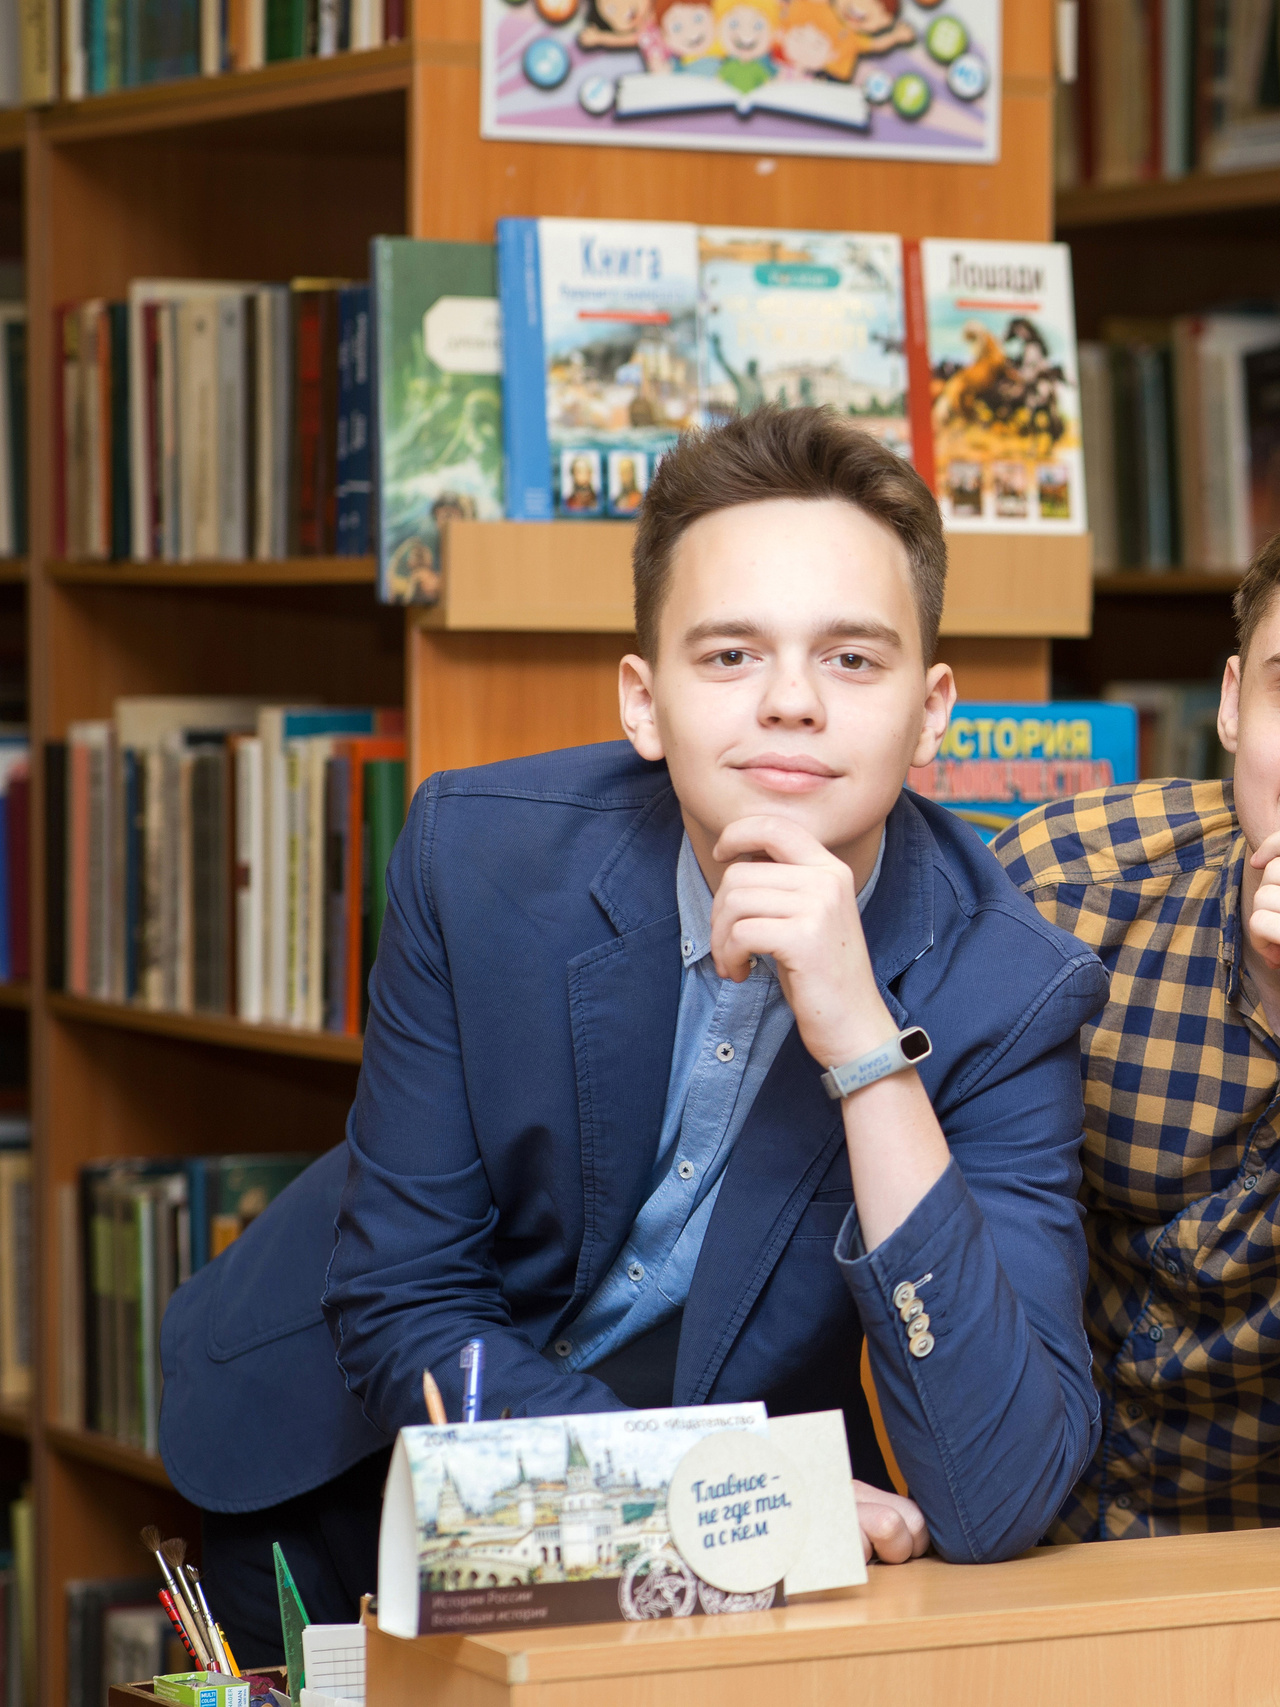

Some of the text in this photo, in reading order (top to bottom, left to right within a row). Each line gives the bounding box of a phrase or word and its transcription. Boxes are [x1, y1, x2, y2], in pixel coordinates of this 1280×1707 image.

[579, 232, 662, 281] Книга
[949, 252, 1045, 294] Лошади
[624, 1418, 659, 1432] ООО
[691, 1473, 767, 1503] Главное
[698, 1492, 792, 1527] не где ты,
[703, 1520, 769, 1549] а с кем
